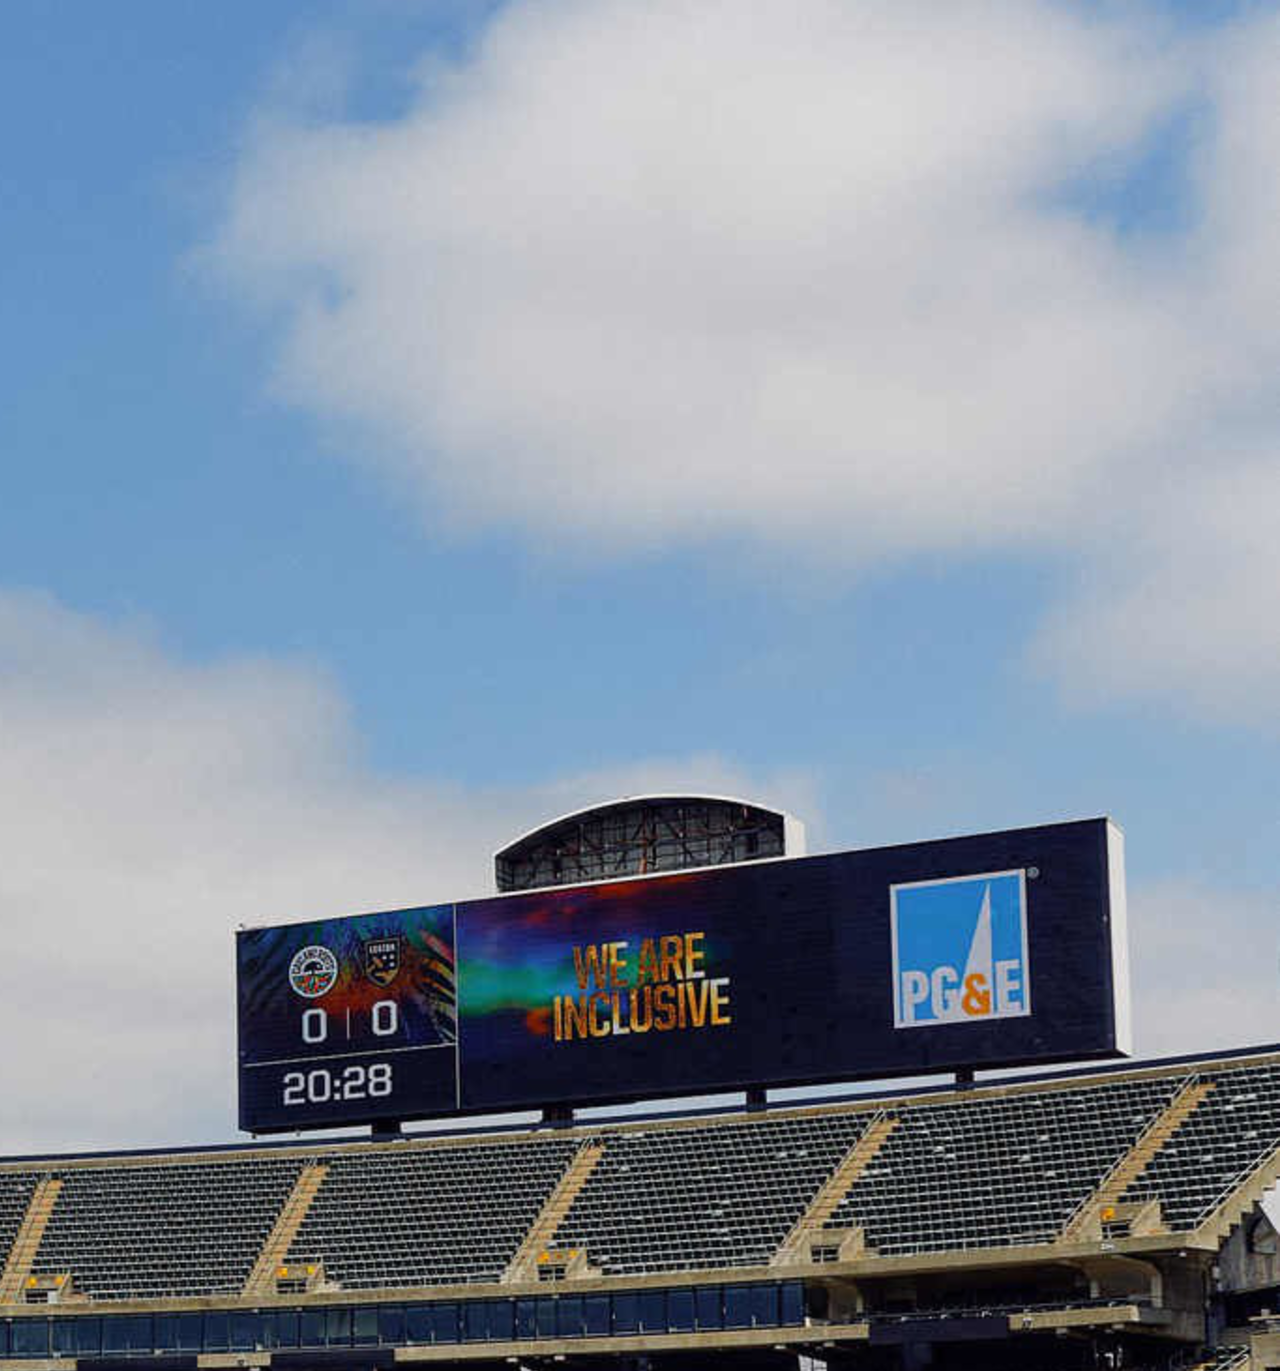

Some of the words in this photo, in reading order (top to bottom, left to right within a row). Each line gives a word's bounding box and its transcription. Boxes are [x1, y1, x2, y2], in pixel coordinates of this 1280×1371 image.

[572, 941, 628, 989] WE
[636, 932, 705, 984] ARE
[553, 977, 731, 1041] INCLUSIVE
[901, 959, 1023, 1023] PG&E
[302, 1008, 327, 1043] 0
[372, 1000, 397, 1035] 0
[283, 1063, 391, 1105] 20:28
